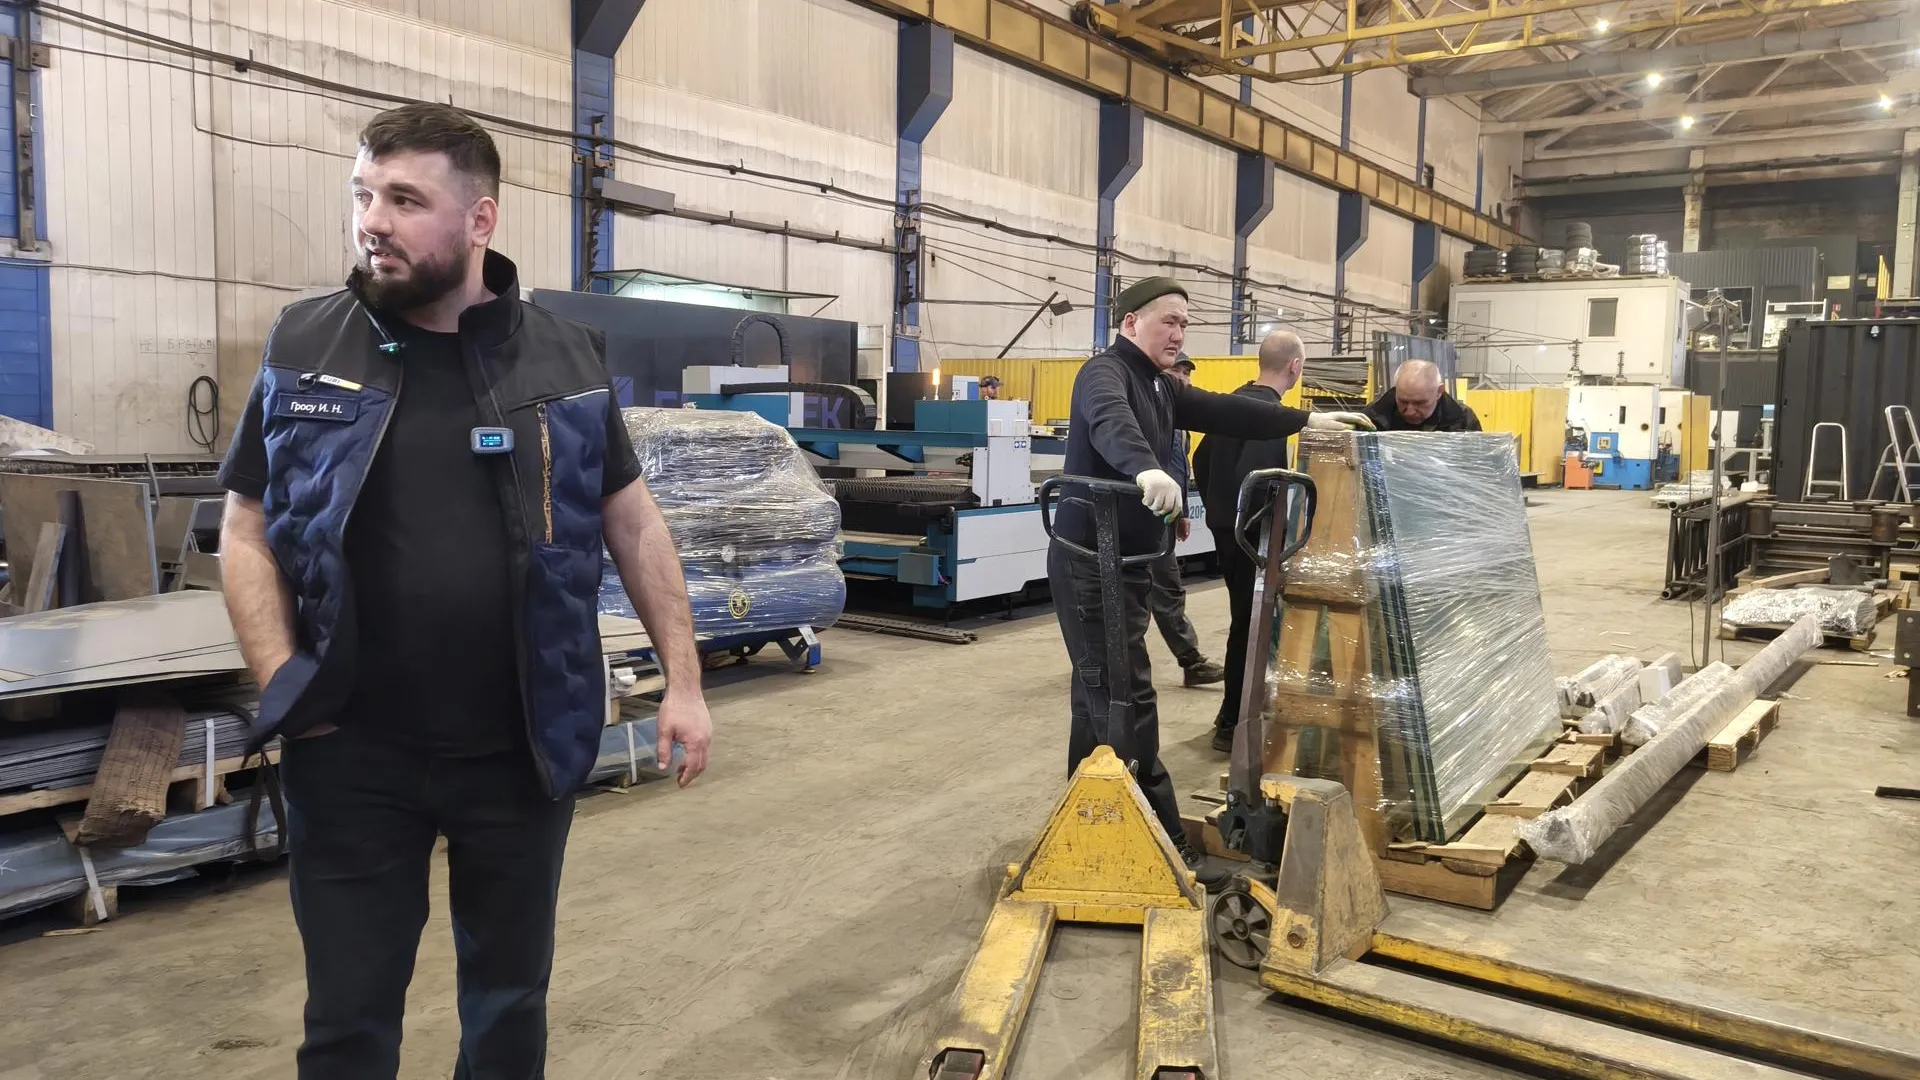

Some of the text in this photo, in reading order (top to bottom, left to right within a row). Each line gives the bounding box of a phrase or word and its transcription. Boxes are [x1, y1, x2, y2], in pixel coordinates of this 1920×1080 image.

[290, 401, 343, 414] Гросу И. Н.
